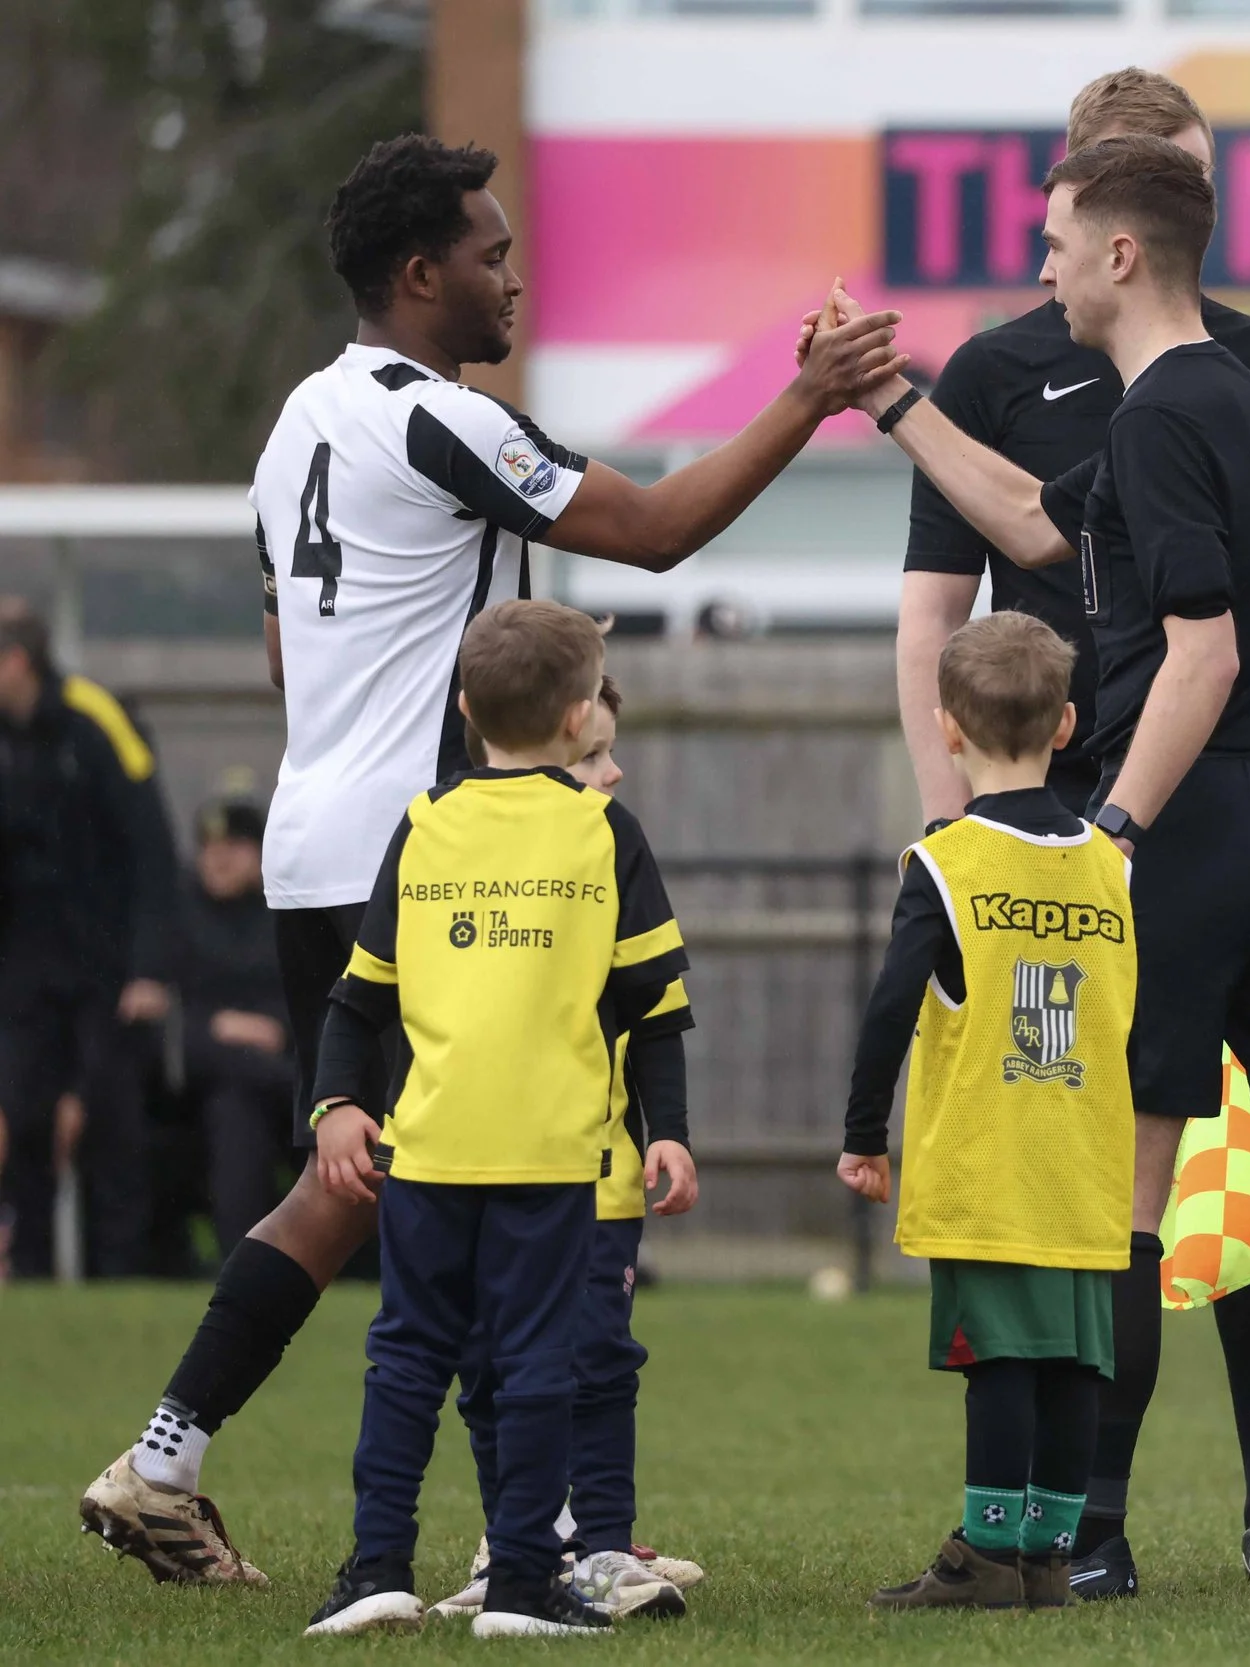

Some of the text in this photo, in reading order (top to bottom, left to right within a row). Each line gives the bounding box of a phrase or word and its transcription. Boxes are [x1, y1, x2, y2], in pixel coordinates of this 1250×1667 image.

[889, 130, 1067, 283] TH
[290, 442, 342, 617] 4
[320, 599, 334, 610] AR
[400, 879, 607, 904] ABBEY RANGERS FC
[489, 910, 509, 929] TA
[971, 893, 1125, 943] Kappa
[487, 928, 554, 949] SPORTS
[1006, 1060, 1029, 1072] ABBEY
[1029, 1065, 1067, 1078] RANGERS
